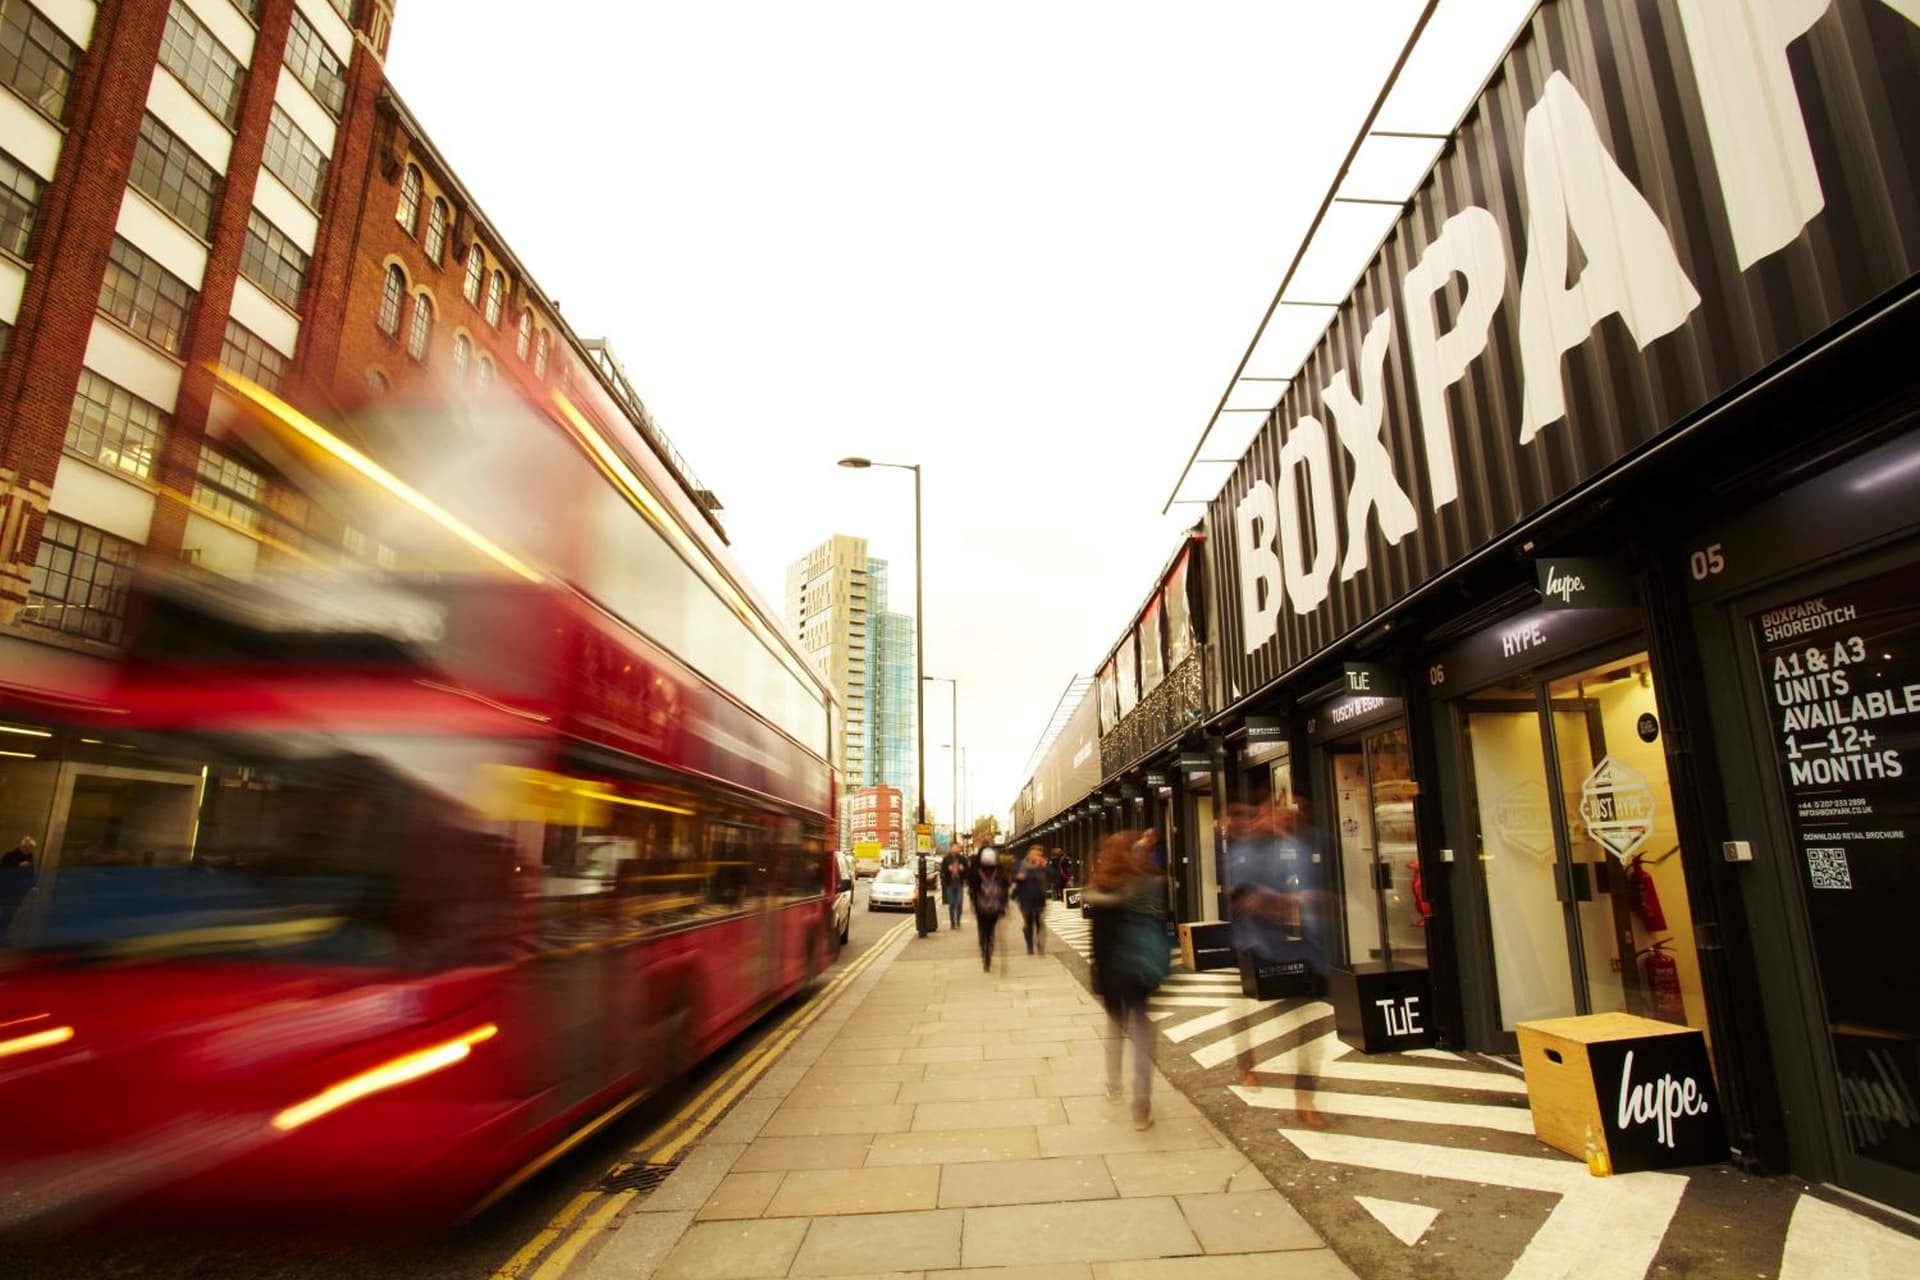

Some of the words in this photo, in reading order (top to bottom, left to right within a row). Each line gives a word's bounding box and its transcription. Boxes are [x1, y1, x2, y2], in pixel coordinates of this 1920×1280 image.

[1690, 543, 1725, 581] 05
[1546, 565, 1585, 603] hype.
[1761, 598, 1828, 629] BOXPARK
[1764, 605, 1857, 642] SHOREDITCH
[1502, 622, 1547, 658] HYPE.
[1430, 664, 1445, 686] 06
[1774, 652, 1804, 681] A1
[1805, 647, 1829, 673] &
[1833, 636, 1867, 667] A3
[1775, 670, 1850, 706] UNITS
[1783, 684, 1920, 733] AVAILABLE
[1789, 750, 1903, 786] MONTHS
[1803, 832, 1841, 840] DOWNLOAD
[1865, 830, 1904, 839] BROCHURE
[1617, 1050, 1709, 1149] hype.
